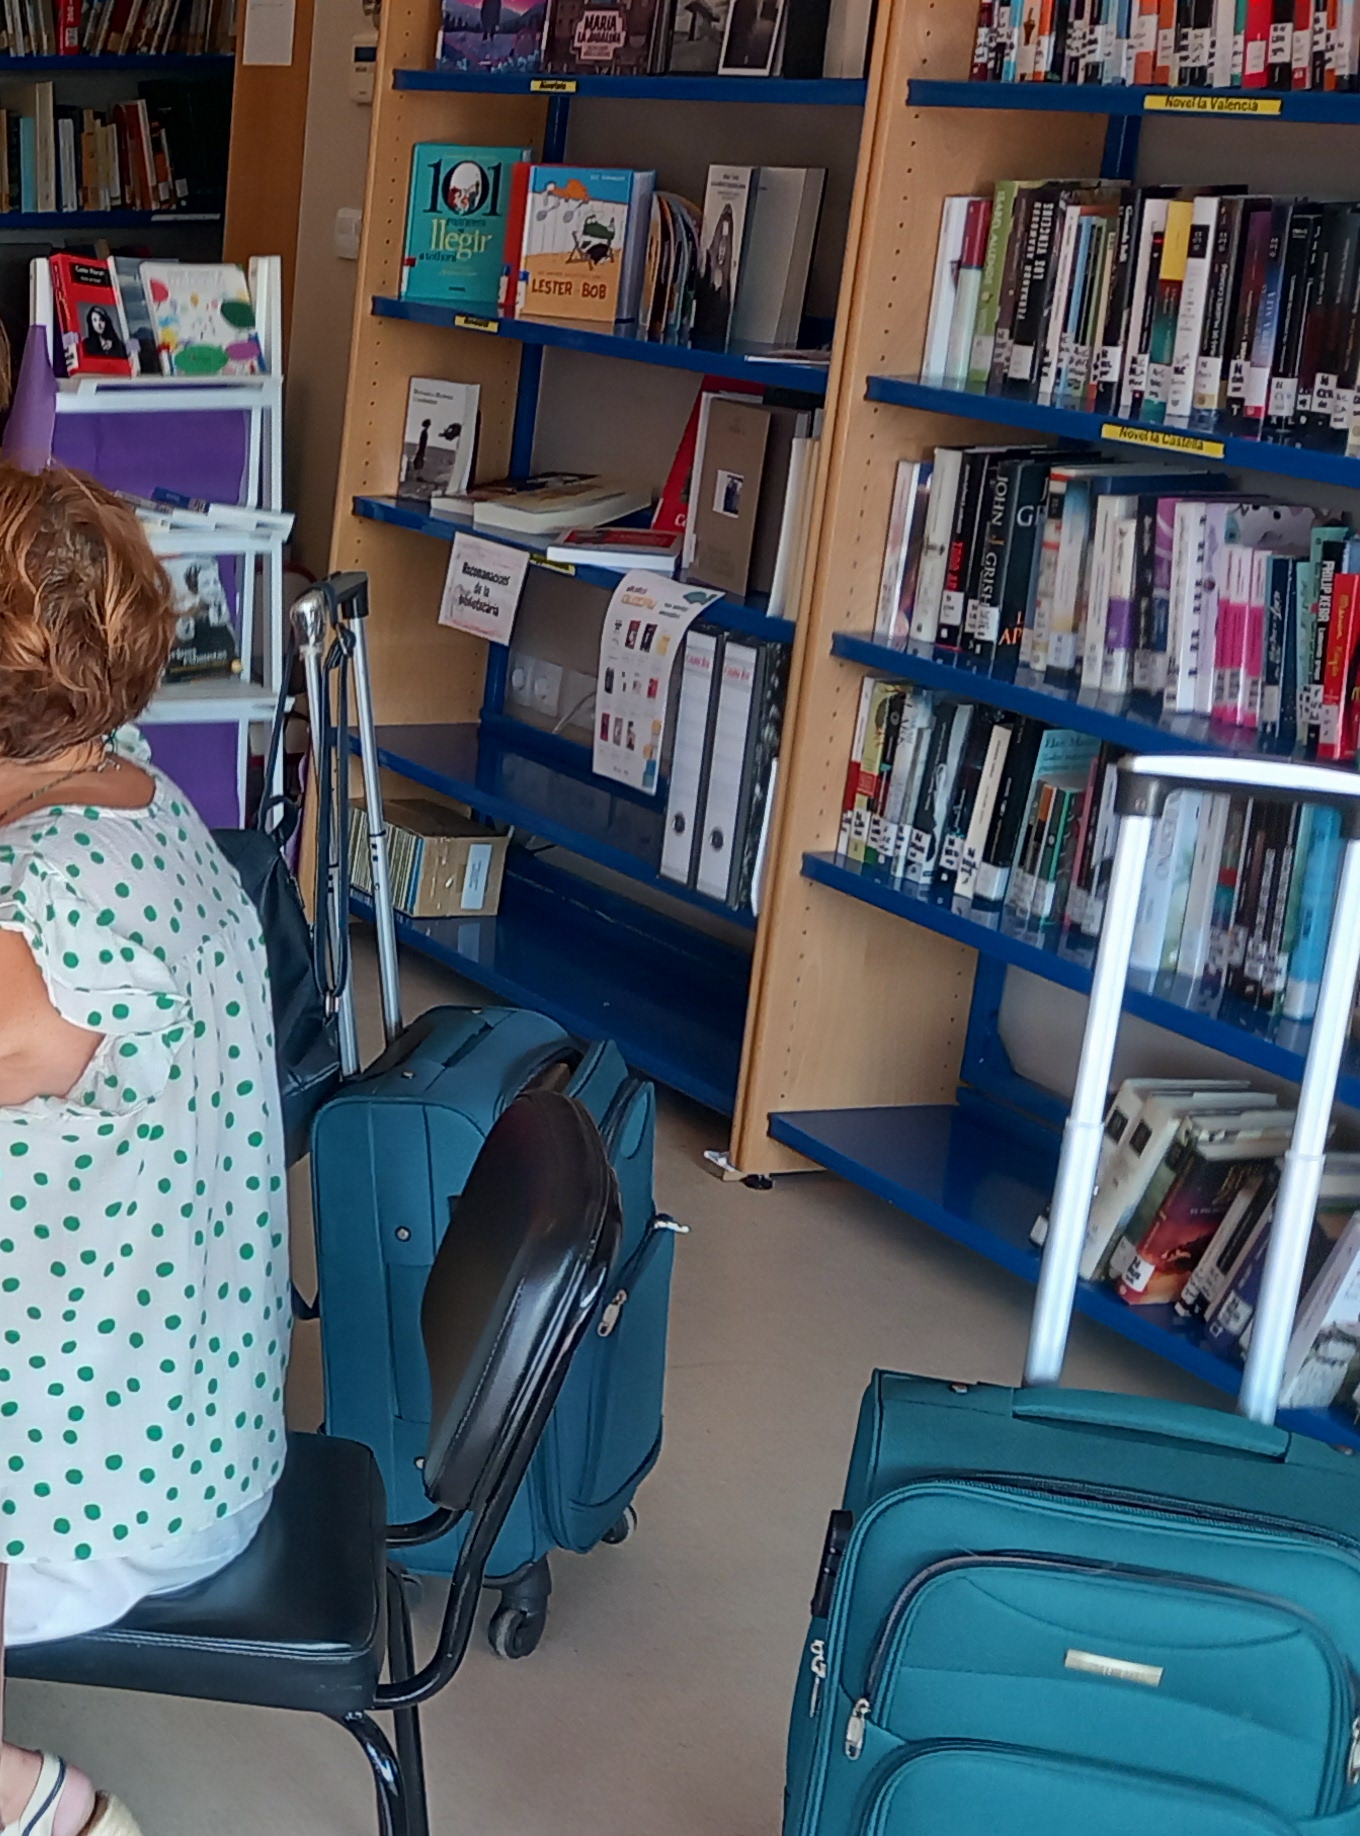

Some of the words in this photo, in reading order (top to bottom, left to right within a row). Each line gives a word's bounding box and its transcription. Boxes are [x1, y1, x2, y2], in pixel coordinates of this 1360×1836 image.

[422, 158, 503, 216] 101
[429, 218, 493, 260] llegir
[1032, 260, 1046, 279] LOS
[531, 278, 573, 296] LESTER
[581, 282, 607, 300] BOB
[992, 477, 1008, 526] JOHN
[1321, 560, 1335, 595] PHILIP
[1318, 595, 1332, 622] KERR
